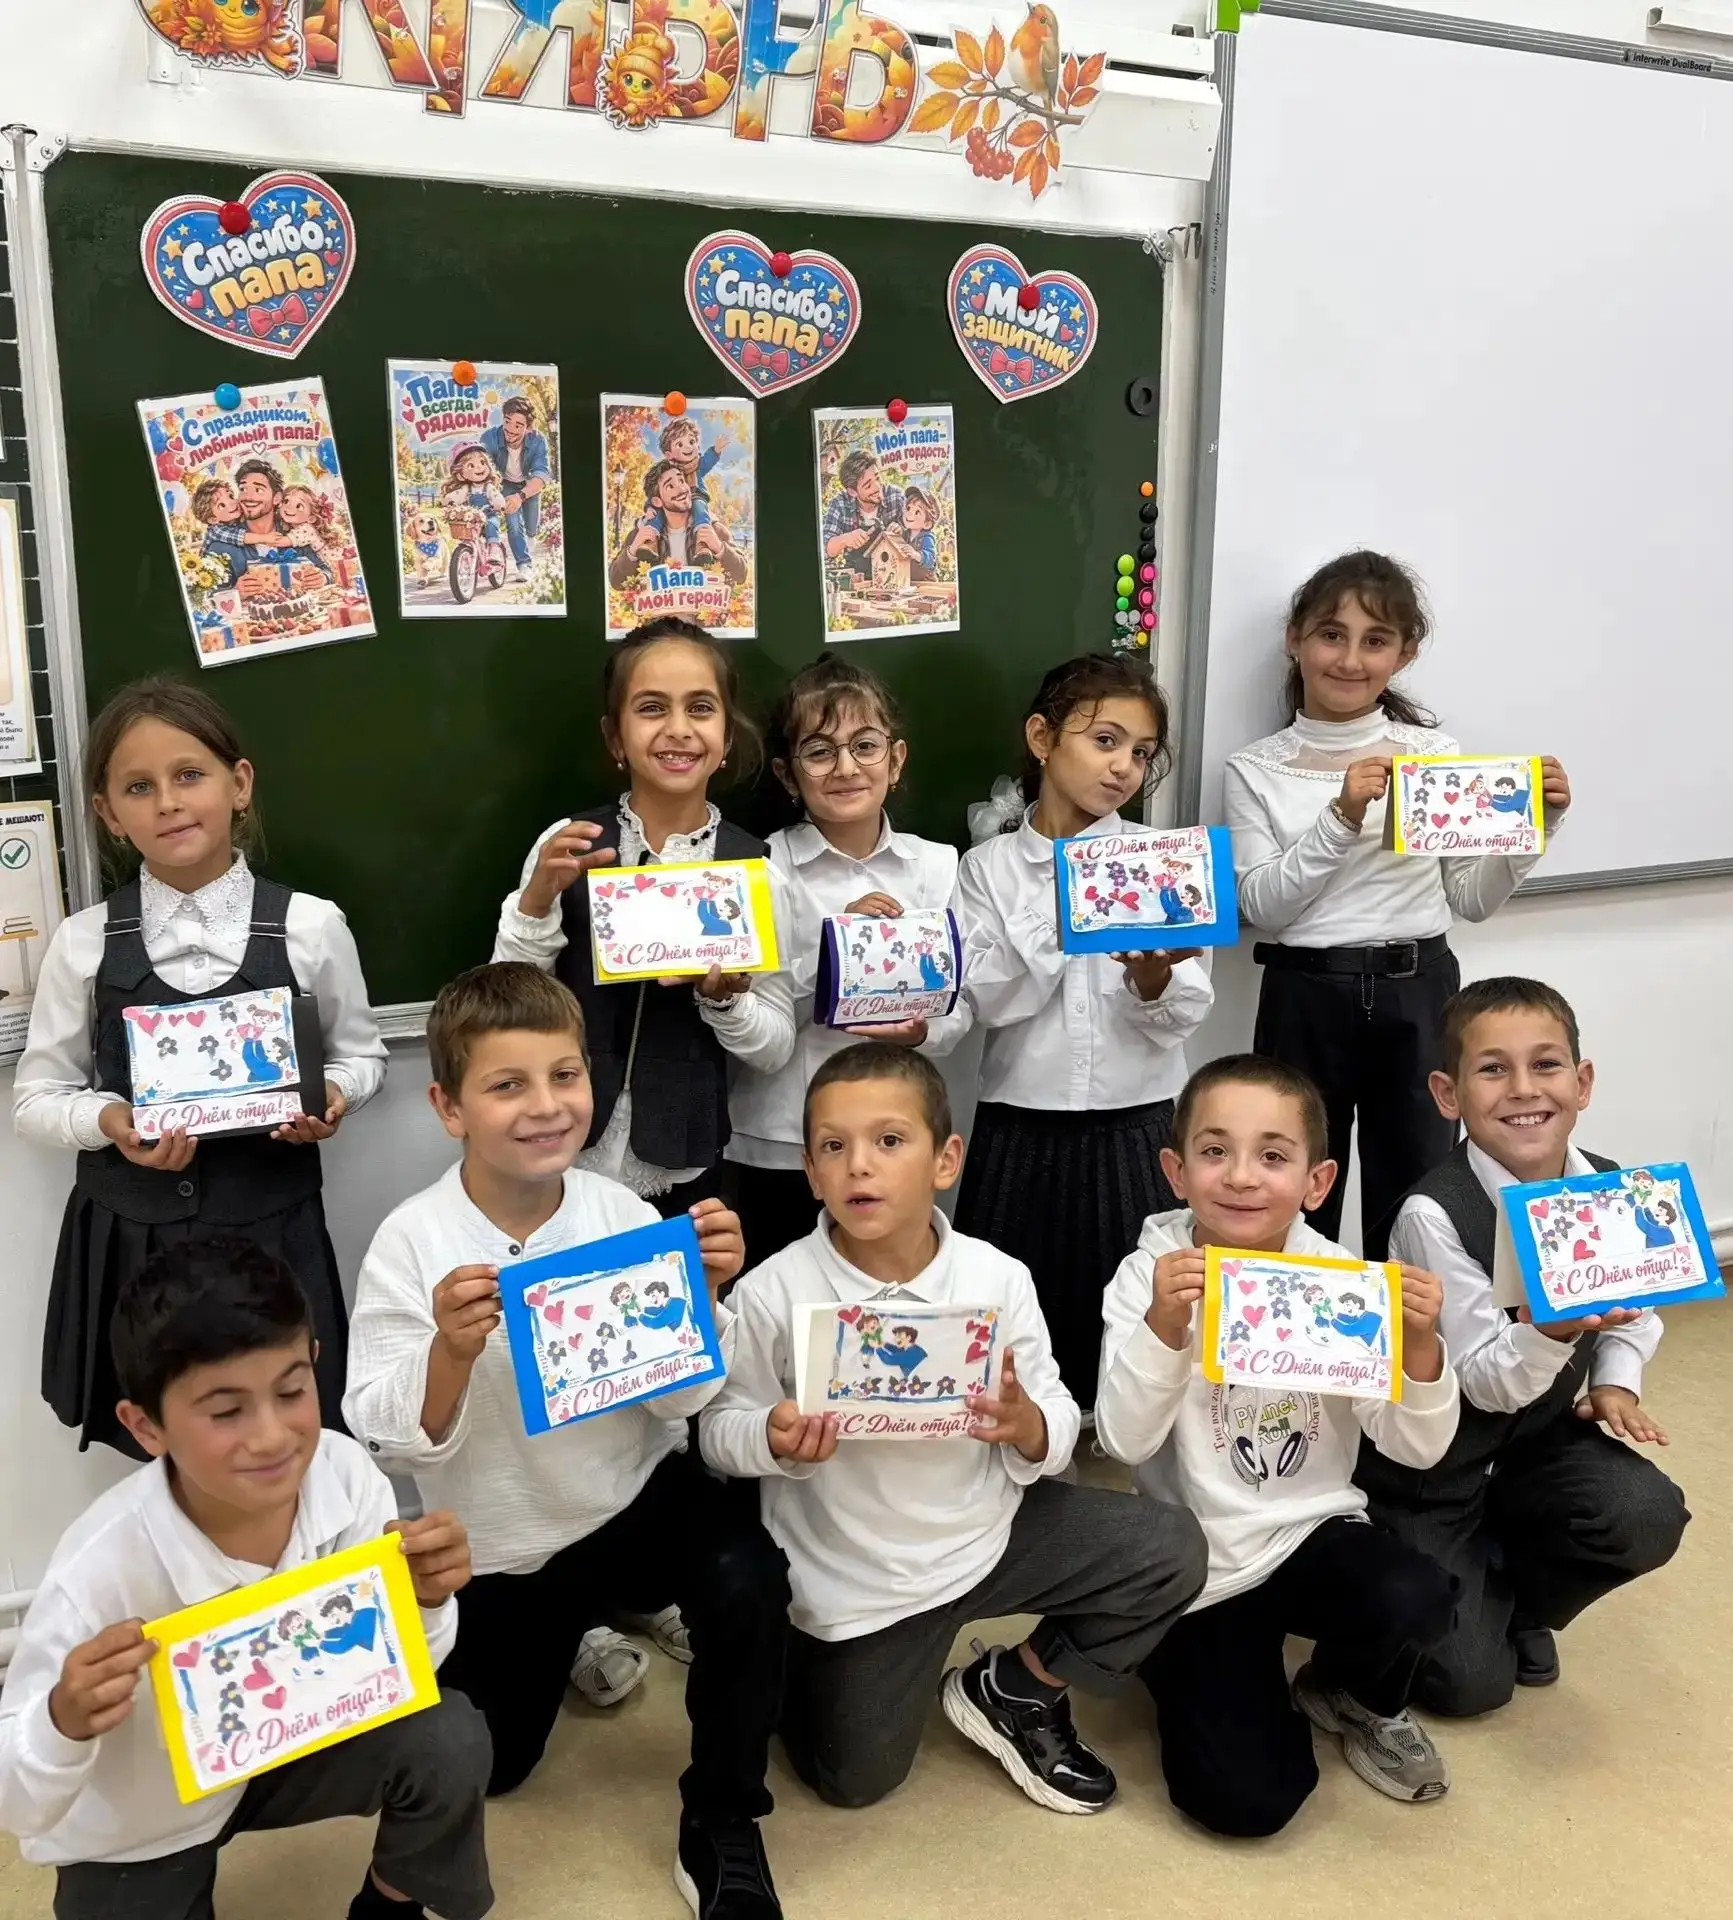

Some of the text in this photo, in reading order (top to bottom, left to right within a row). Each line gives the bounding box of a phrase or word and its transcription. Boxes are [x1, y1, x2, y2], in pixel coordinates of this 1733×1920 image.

[1672, 57, 1712, 72] DualBoard
[182, 214, 334, 286] Спасибо,
[209, 252, 326, 317] папа
[715, 269, 836, 332] Спасибо,
[984, 282, 1060, 338] Мой
[725, 308, 820, 357] папа
[406, 376, 479, 406] Папа
[421, 398, 474, 418] всегда
[182, 408, 311, 446] С праздником,
[415, 409, 489, 442] рядом!
[875, 429, 907, 454] Мой
[188, 421, 321, 467] любимый папа!
[881, 444, 950, 466] моя гордость!
[650, 567, 704, 591] Папа
[638, 588, 729, 612] мой герой!
[5, 813, 45, 825] МЕШАЮТ!
[1087, 832, 1192, 859] С Днём отца!
[1425, 831, 1524, 851] С Днём отца!
[627, 939, 738, 965] С Днём отца!
[853, 996, 936, 1017] С Днём отца!
[159, 1096, 283, 1132] С Днём отца!
[1567, 1251, 1678, 1295] С Днём отца!
[1250, 1349, 1377, 1386] С Днём отца!
[573, 1388, 590, 1416] С
[592, 1376, 644, 1409] Днём
[1234, 1392, 1298, 1428] Plnet
[844, 1414, 969, 1438] С Днём отца!
[230, 1679, 382, 1768] С Днём отца!
